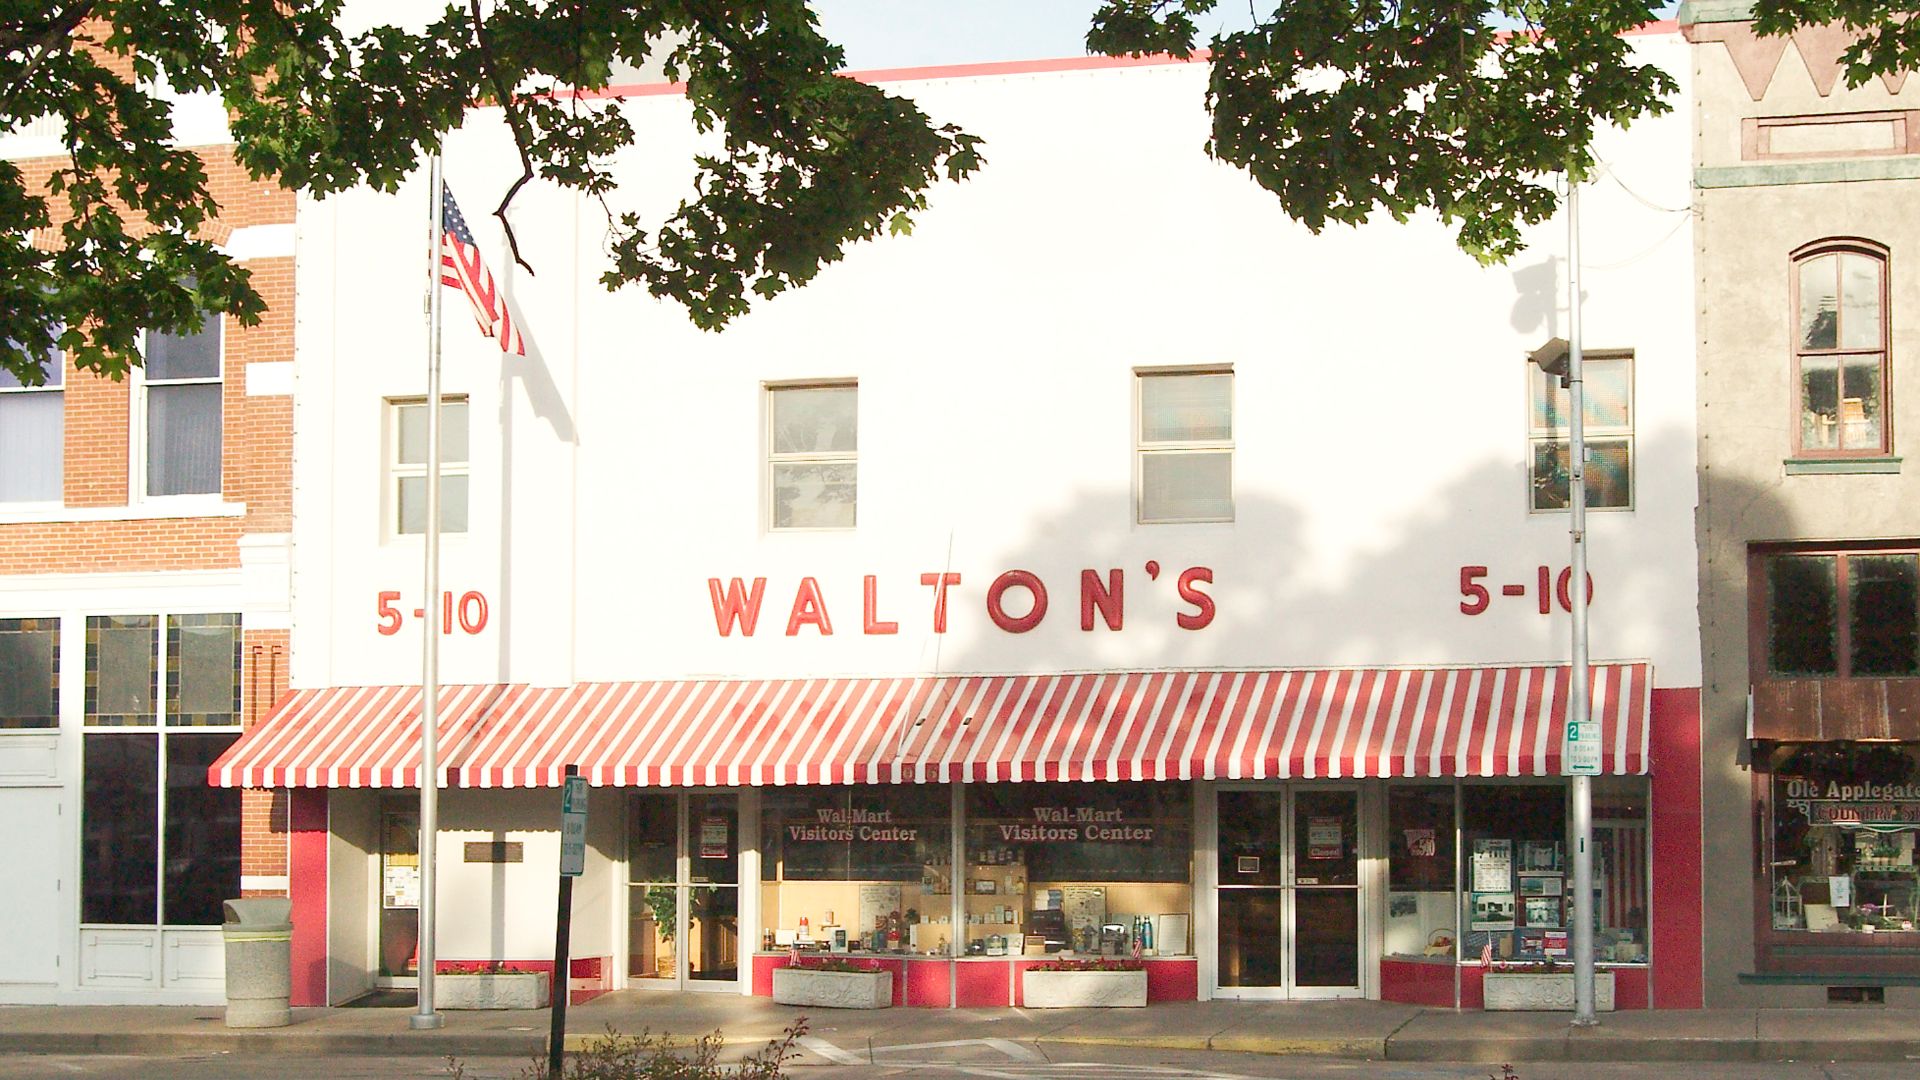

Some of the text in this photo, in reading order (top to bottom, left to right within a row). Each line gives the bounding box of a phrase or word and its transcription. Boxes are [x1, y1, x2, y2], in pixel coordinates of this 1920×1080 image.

[708, 560, 1216, 636] WALTON'S
[1460, 565, 1593, 616] 5-10
[377, 591, 489, 636] 5-10
[1569, 725, 1577, 739] 2
[817, 808, 892, 824] Wal-Mart
[1033, 807, 1123, 822] Wal-Mart
[789, 826, 917, 841] Visitors Center
[1000, 825, 1153, 840] Visitors Center
